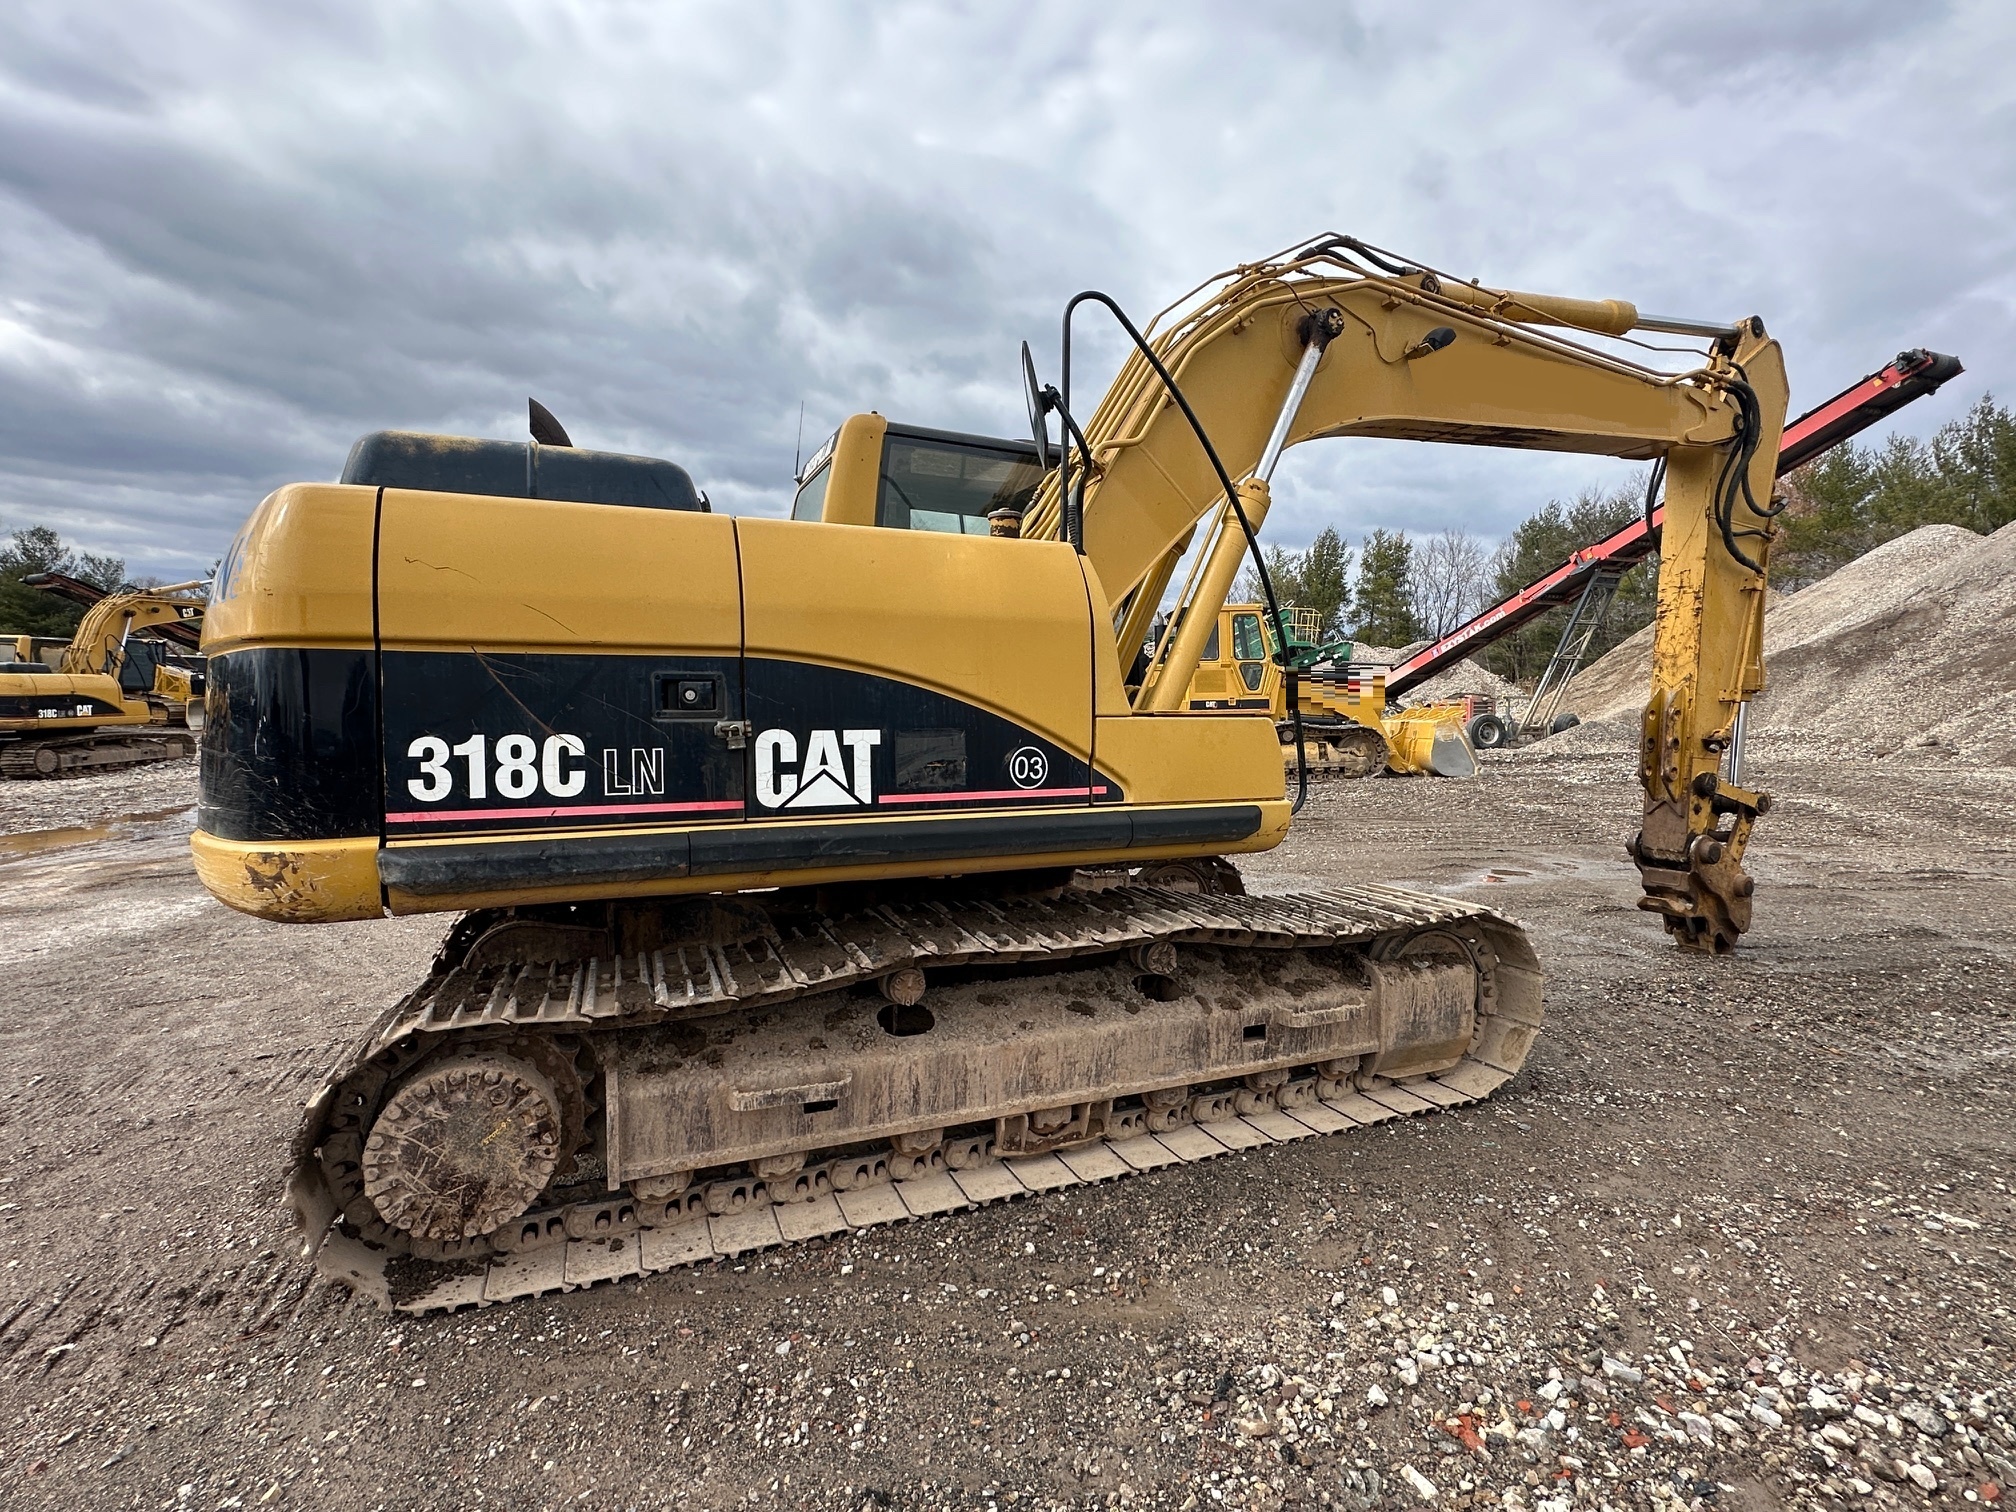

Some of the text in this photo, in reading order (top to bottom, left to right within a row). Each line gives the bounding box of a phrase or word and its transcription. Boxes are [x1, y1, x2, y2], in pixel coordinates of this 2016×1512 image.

[37, 708, 58, 718] 318C
[76, 704, 94, 717] CAT
[407, 734, 665, 802] 318C LN
[755, 728, 881, 809] CAT
[1014, 756, 1043, 780] 03
